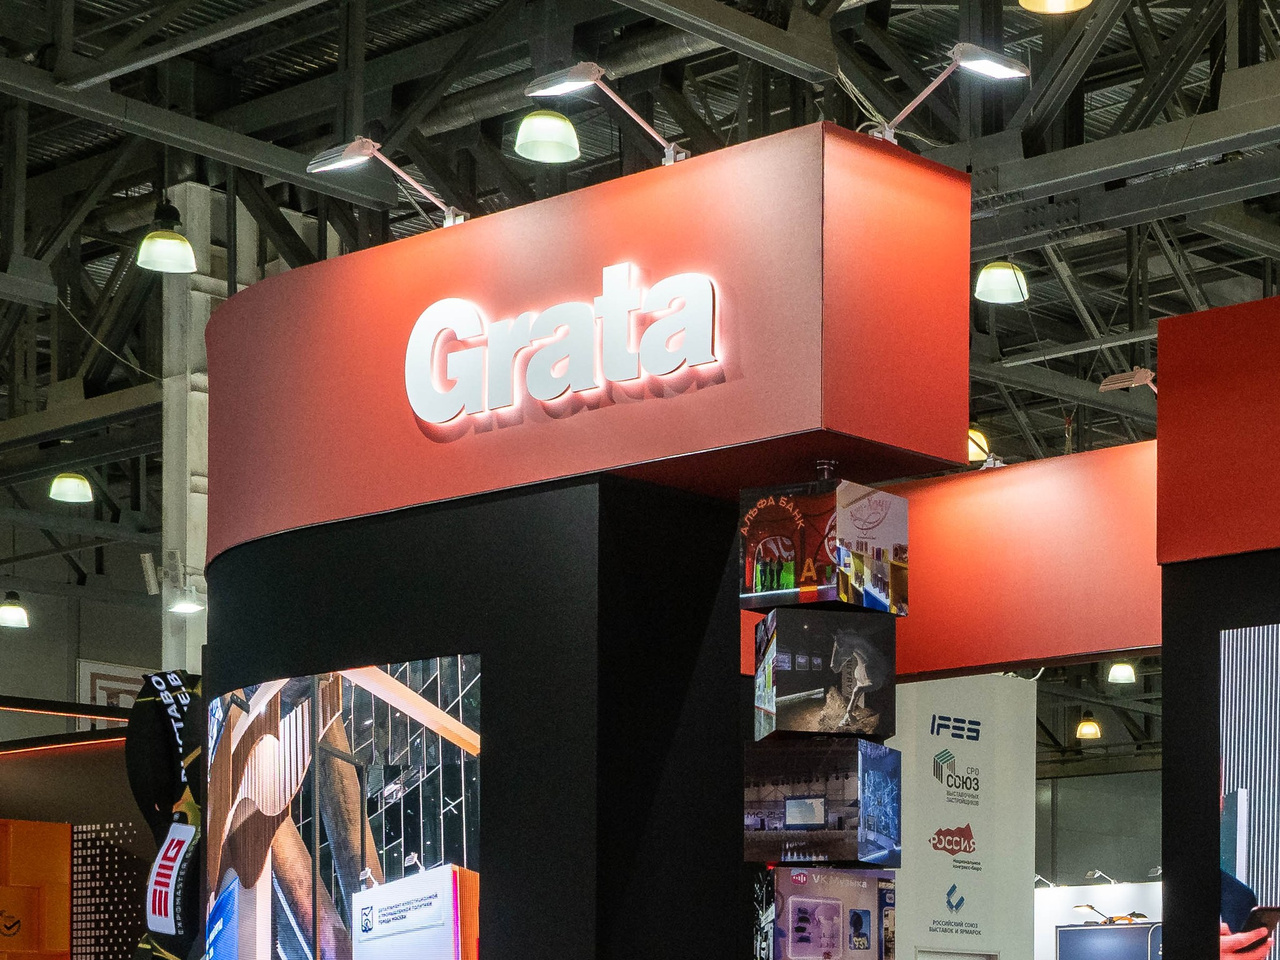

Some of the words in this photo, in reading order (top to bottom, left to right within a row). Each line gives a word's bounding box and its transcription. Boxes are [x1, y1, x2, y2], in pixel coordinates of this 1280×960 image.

[405, 261, 719, 424] Grata
[740, 496, 775, 536] АЛЬФА
[779, 496, 805, 530] БАНК
[930, 714, 981, 742] IFES
[946, 774, 980, 791] СОЮЗ
[966, 766, 980, 776] СРО
[931, 834, 977, 852] РОССИЯ
